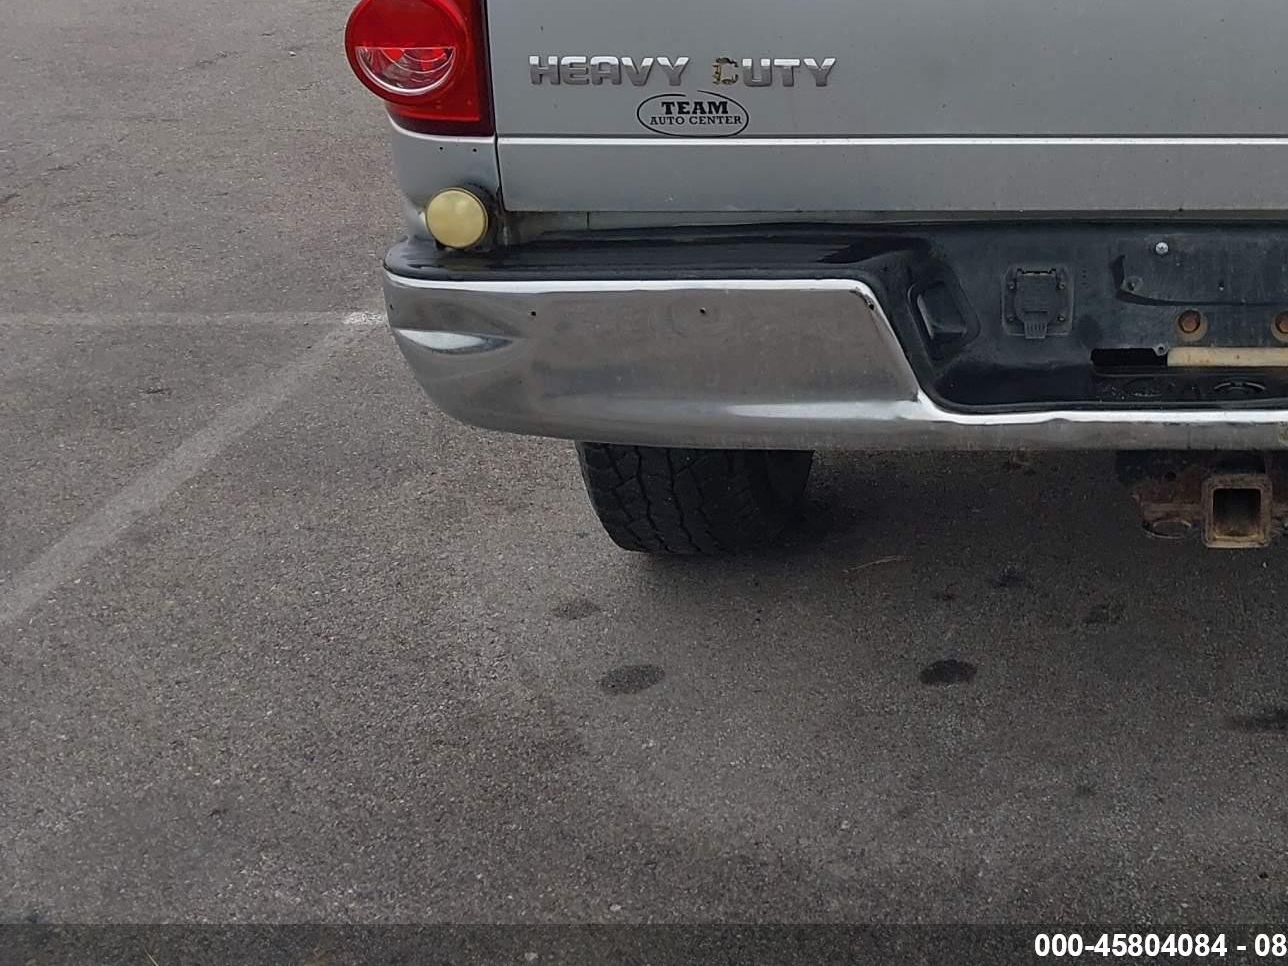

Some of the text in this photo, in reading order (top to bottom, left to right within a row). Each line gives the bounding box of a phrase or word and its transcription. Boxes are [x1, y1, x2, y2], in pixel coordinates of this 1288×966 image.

[528, 55, 690, 86] HEAVY
[661, 100, 729, 115] TEAM
[650, 116, 742, 126] AUTO CENTER
